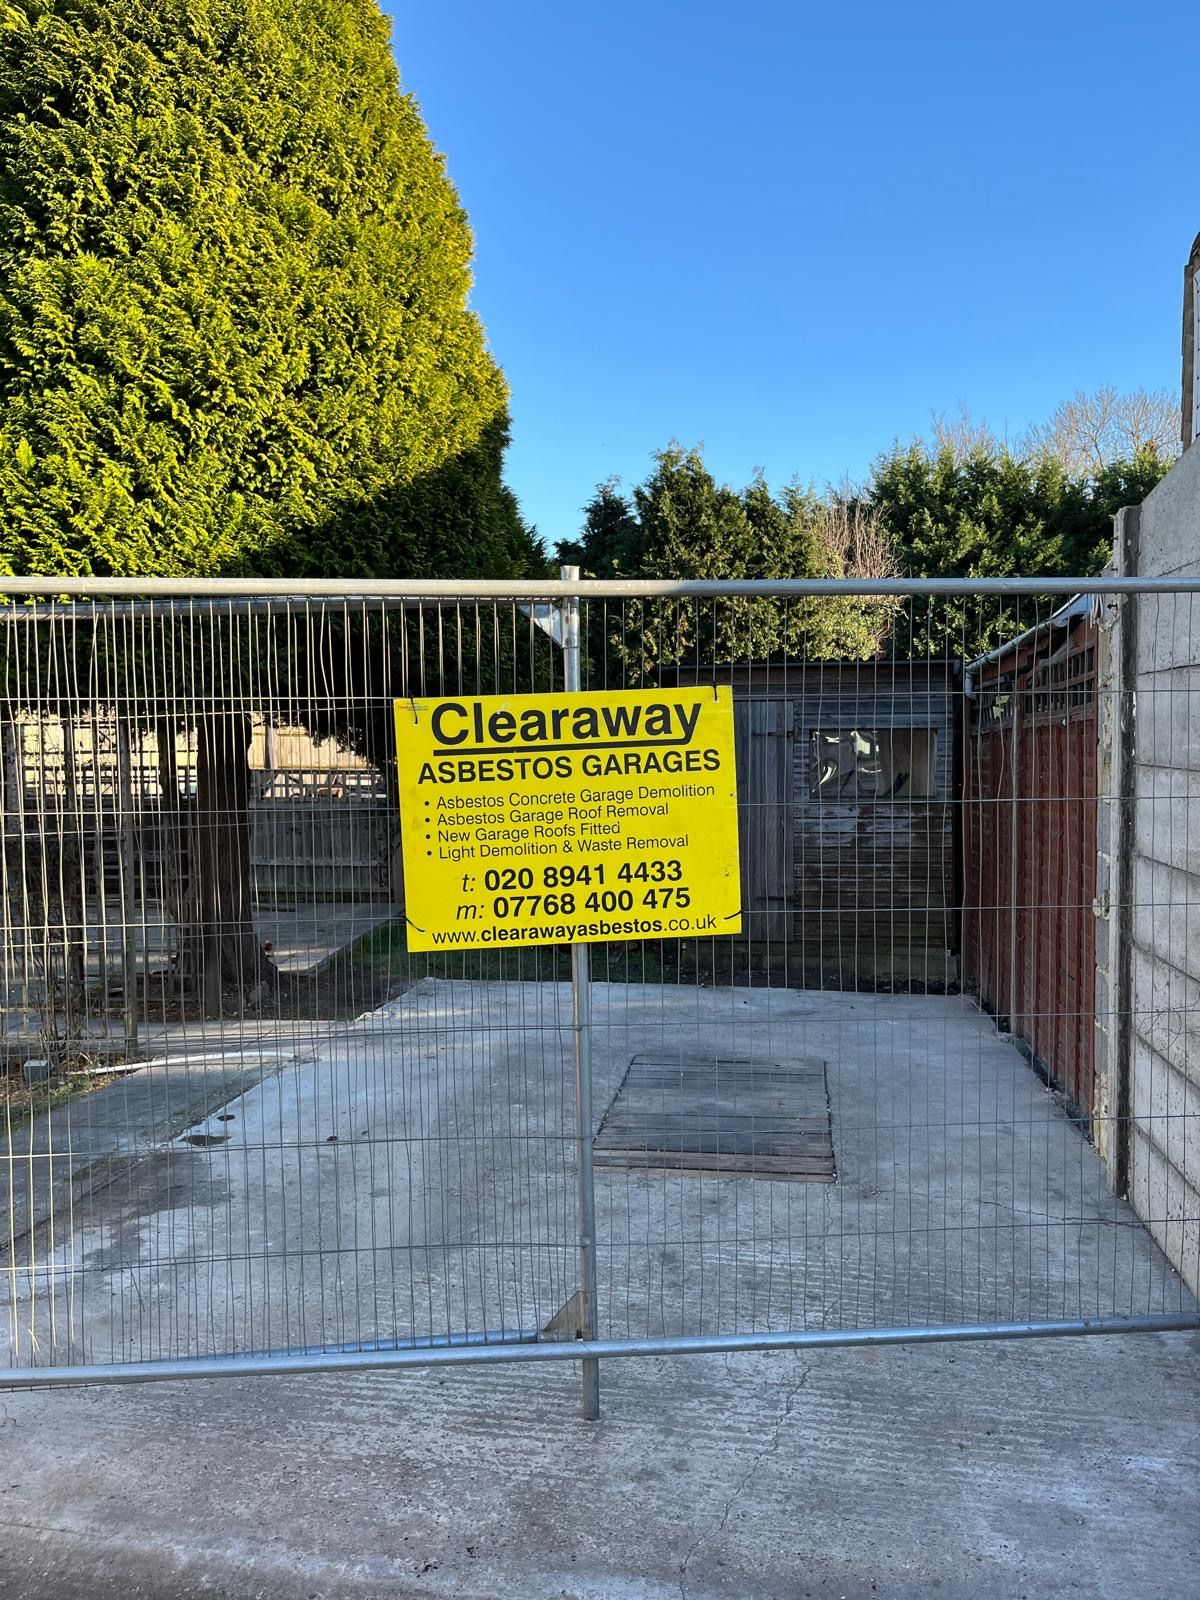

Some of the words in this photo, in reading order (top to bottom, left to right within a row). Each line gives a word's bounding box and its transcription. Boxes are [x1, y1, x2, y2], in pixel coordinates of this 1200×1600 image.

[431, 700, 703, 745] Clearaway
[418, 755, 573, 785] ASBESTOS
[581, 748, 721, 778] GARAGES
[436, 795, 505, 810] Asbestos
[508, 790, 576, 807] Concrete
[579, 787, 634, 805] Garage
[638, 783, 715, 800] Demolition
[437, 812, 505, 827] Asbestos
[509, 809, 565, 825] Garage
[568, 805, 603, 821] Roof
[606, 803, 669, 818] Removal
[437, 829, 471, 843] New
[475, 826, 530, 843] Garage
[533, 823, 577, 839] Roofs
[580, 821, 621, 836] Fitted
[439, 845, 476, 863] Light
[479, 841, 558, 858] Demolition
[562, 840, 574, 854] &
[577, 837, 623, 853] Waste
[627, 834, 689, 850] Removal
[461, 874, 476, 892] t:
[483, 867, 535, 892] 020
[542, 863, 606, 889] 8941
[617, 859, 683, 884] 4433
[456, 903, 485, 921] m:
[492, 892, 577, 919] 07768
[584, 889, 634, 914] 400
[642, 886, 691, 910] 475
[431, 913, 717, 945] www.clearawayasbestos.co.uk
